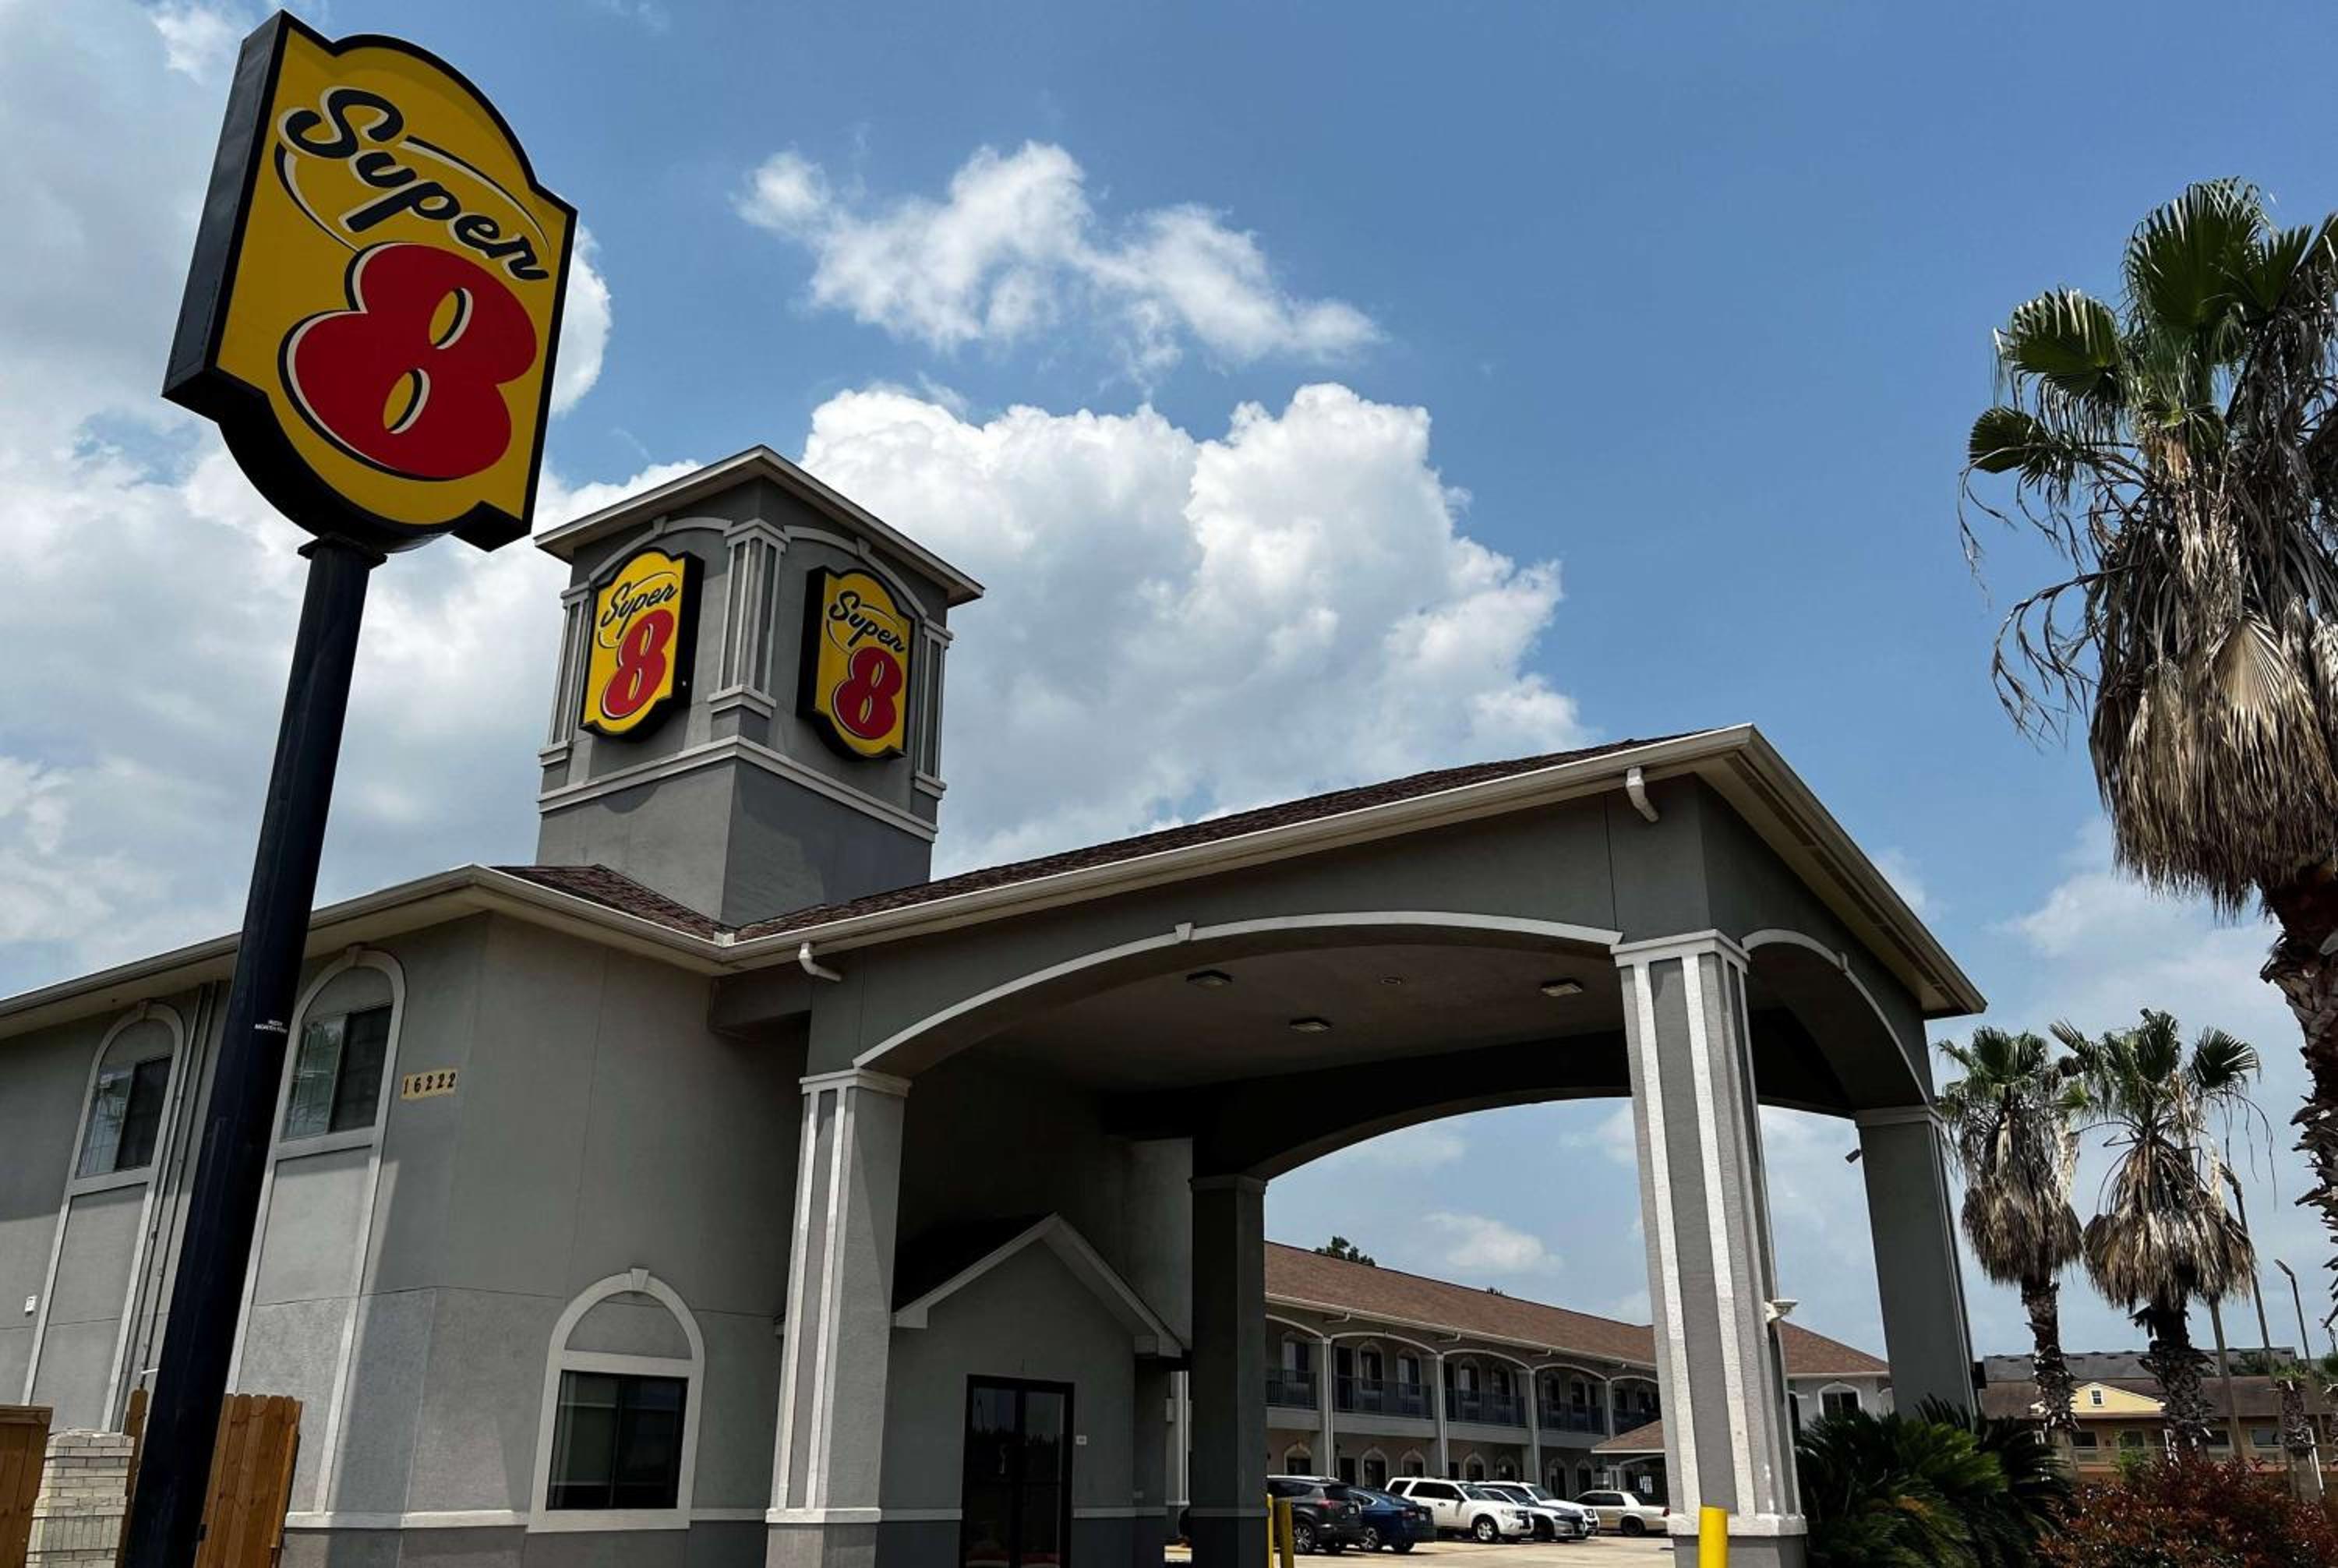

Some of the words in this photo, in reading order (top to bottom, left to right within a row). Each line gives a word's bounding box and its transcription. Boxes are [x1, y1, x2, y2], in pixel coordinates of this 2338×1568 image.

[277, 86, 549, 280] Super
[277, 241, 538, 482] 8
[600, 581, 677, 641] Super
[828, 591, 906, 652] Super
[602, 609, 674, 720] 8
[832, 646, 902, 740] 8
[403, 1072, 457, 1096] 16222
